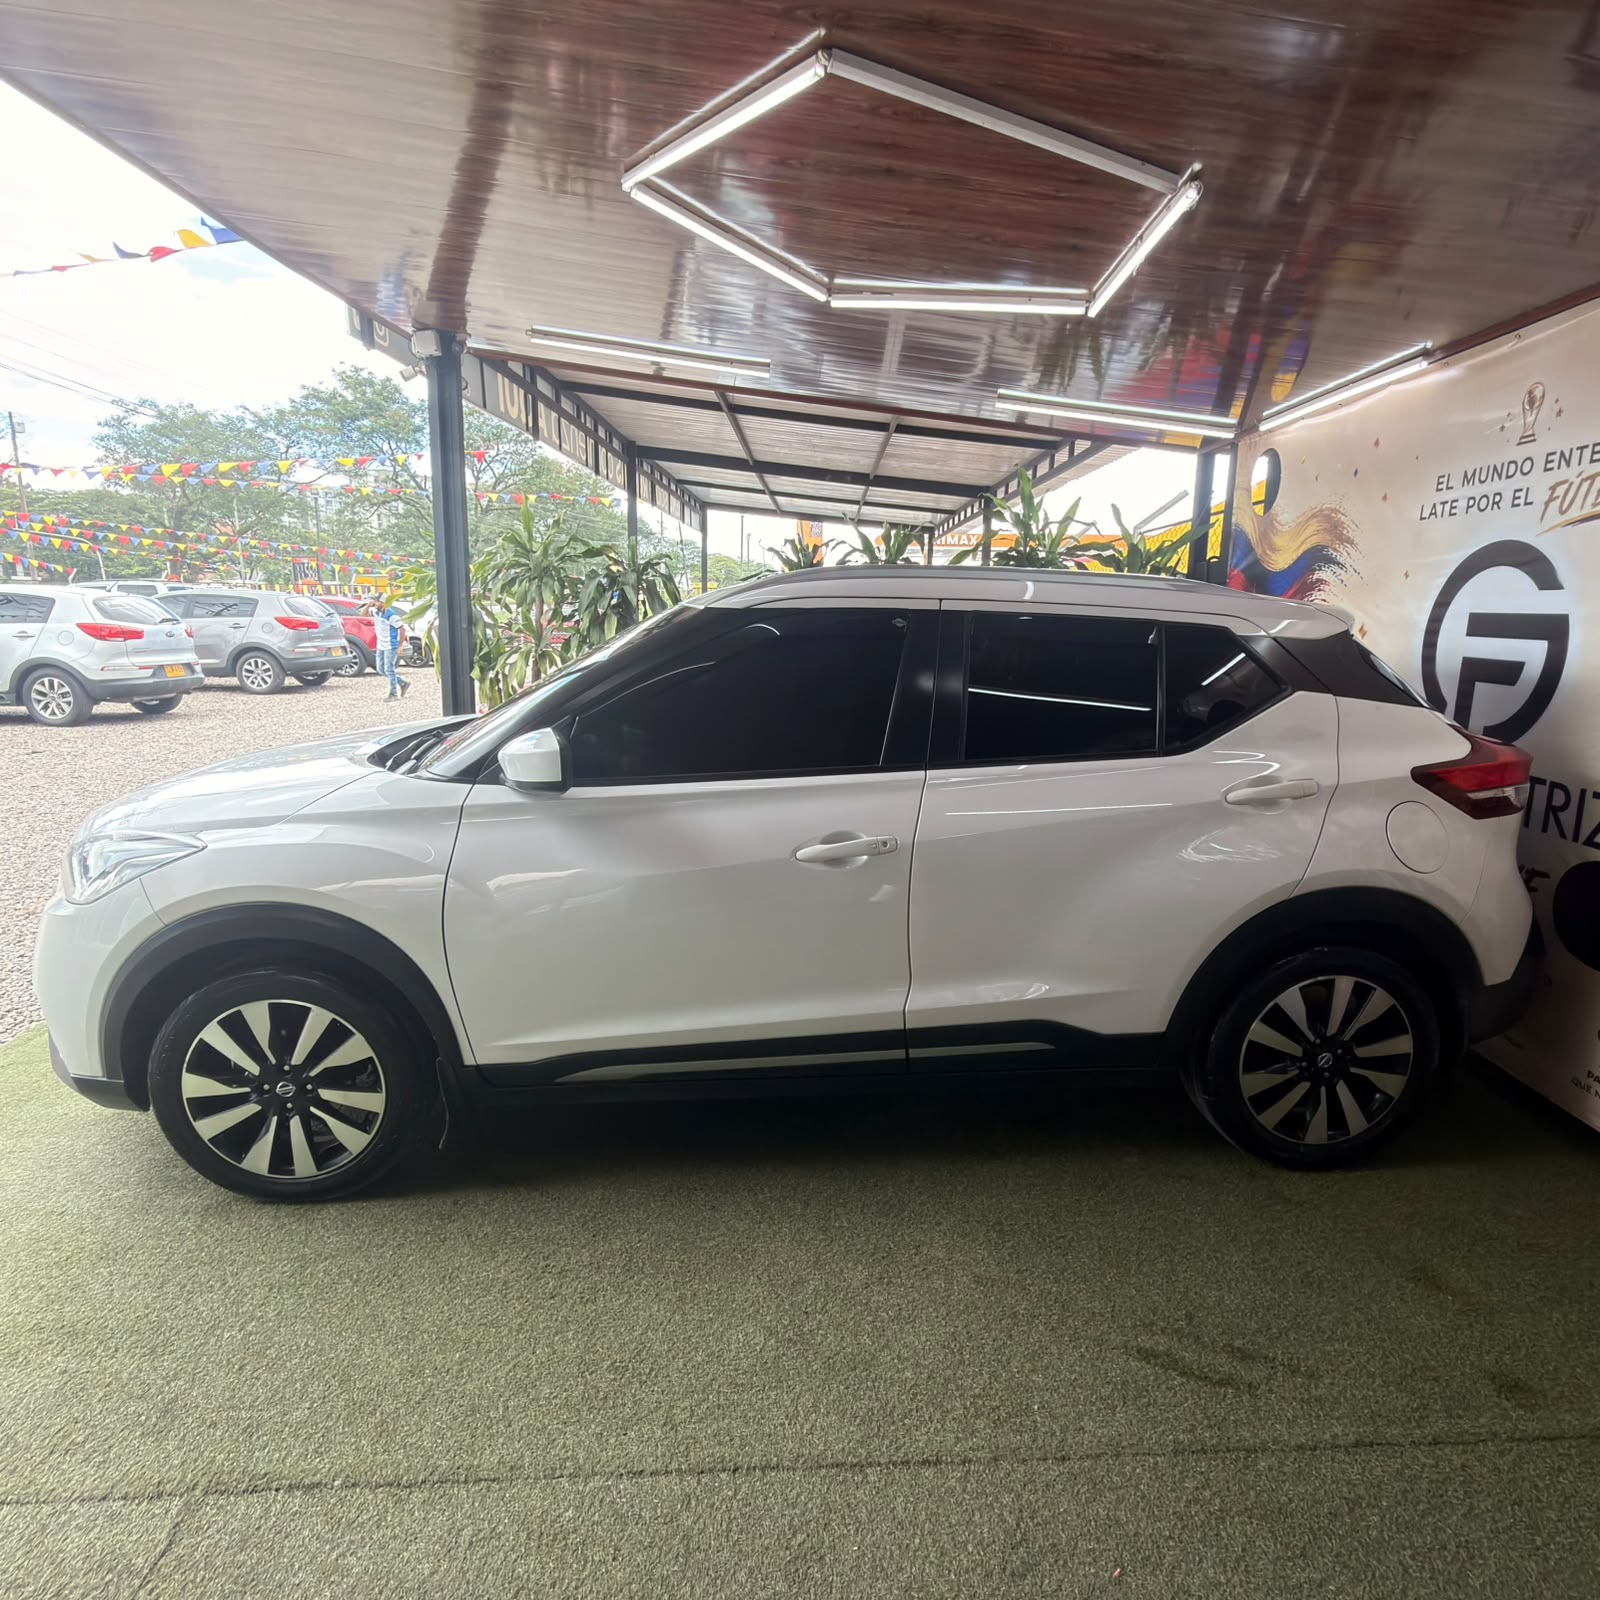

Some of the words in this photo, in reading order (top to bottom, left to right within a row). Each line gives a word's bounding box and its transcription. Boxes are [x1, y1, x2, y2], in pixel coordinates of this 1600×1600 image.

[1435, 472, 1454, 493] EL
[1461, 456, 1535, 488] MUNDO
[1543, 442, 1600, 473] ENTE
[1419, 498, 1459, 521] LATE
[1465, 492, 1503, 515] POR
[1511, 487, 1534, 508] EL
